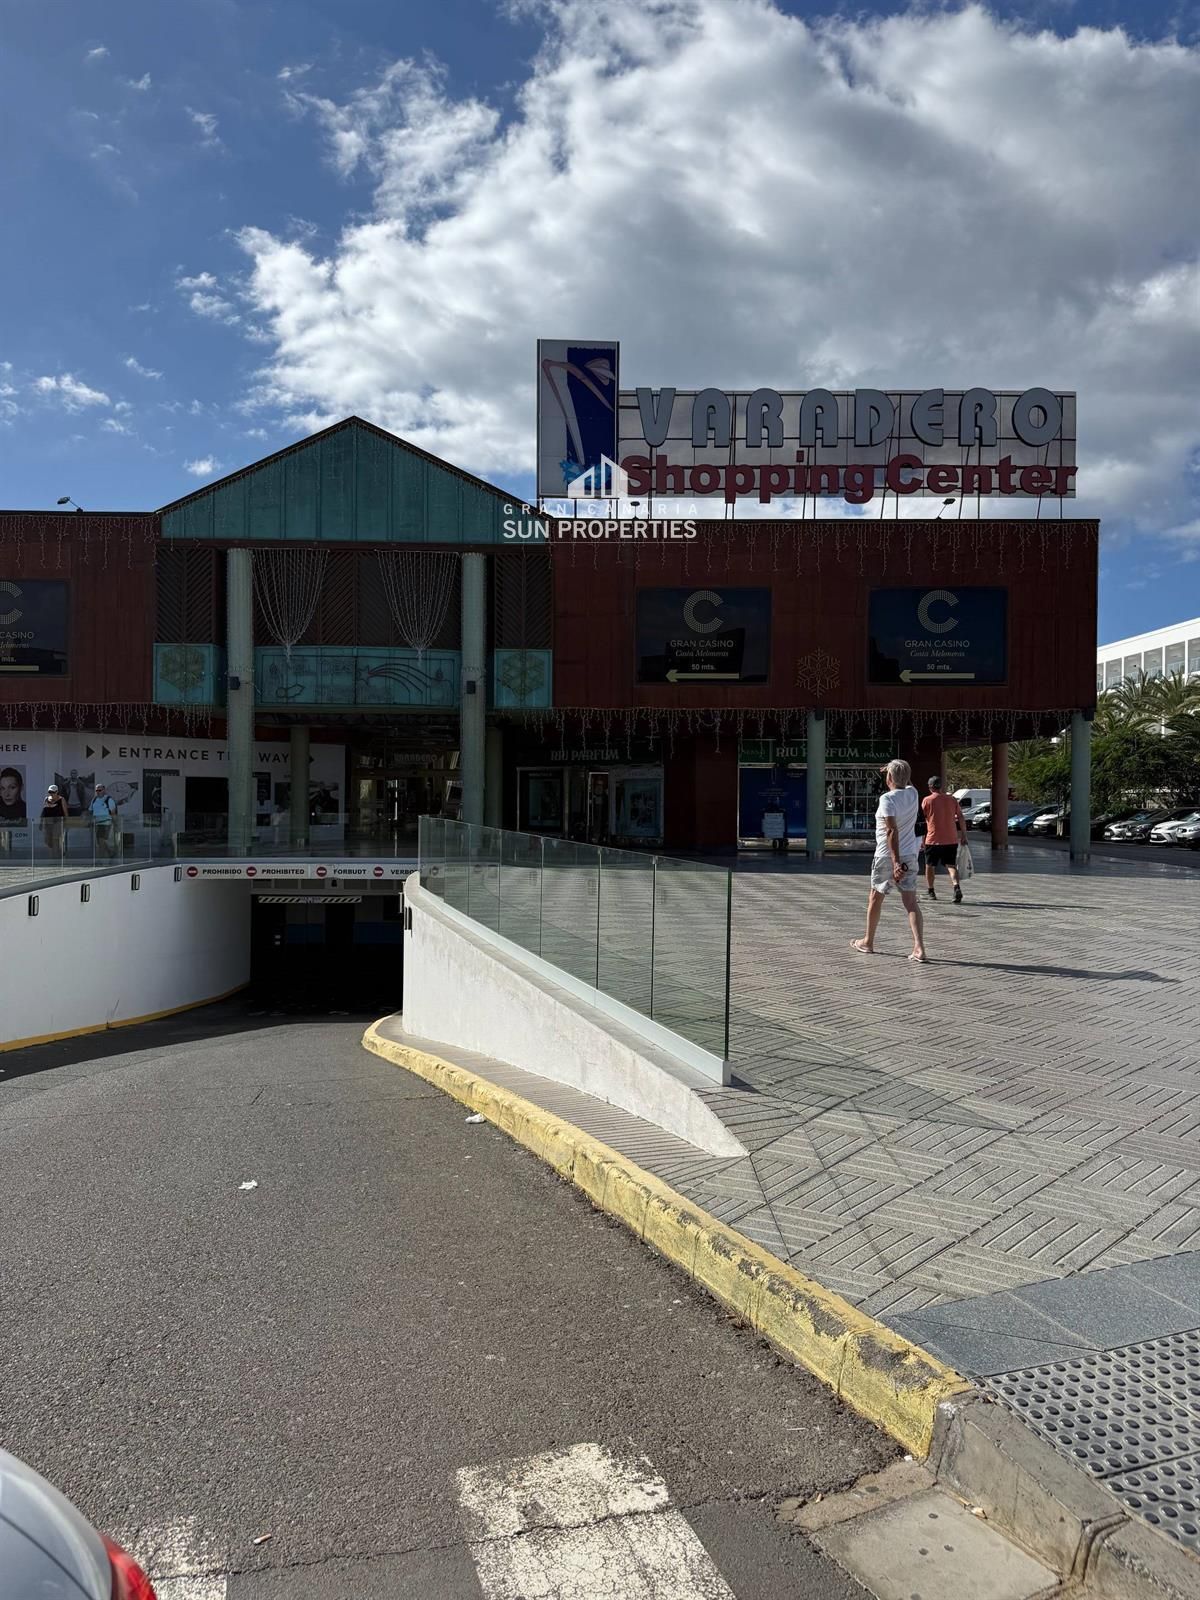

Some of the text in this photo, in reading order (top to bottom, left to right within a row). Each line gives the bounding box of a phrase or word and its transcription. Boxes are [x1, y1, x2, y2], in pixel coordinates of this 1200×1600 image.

[635, 387, 1063, 448] VARADERO
[621, 450, 1078, 504] Shopping Center
[0, 631, 34, 640] CASINO
[670, 639, 735, 648] GRAN CASINO
[904, 640, 970, 648] GRAN CASINO
[119, 747, 209, 760] ENTRANCE
[259, 752, 289, 763] WAY
[551, 749, 619, 761] RIU PARFUM
[776, 747, 798, 758] RIU
